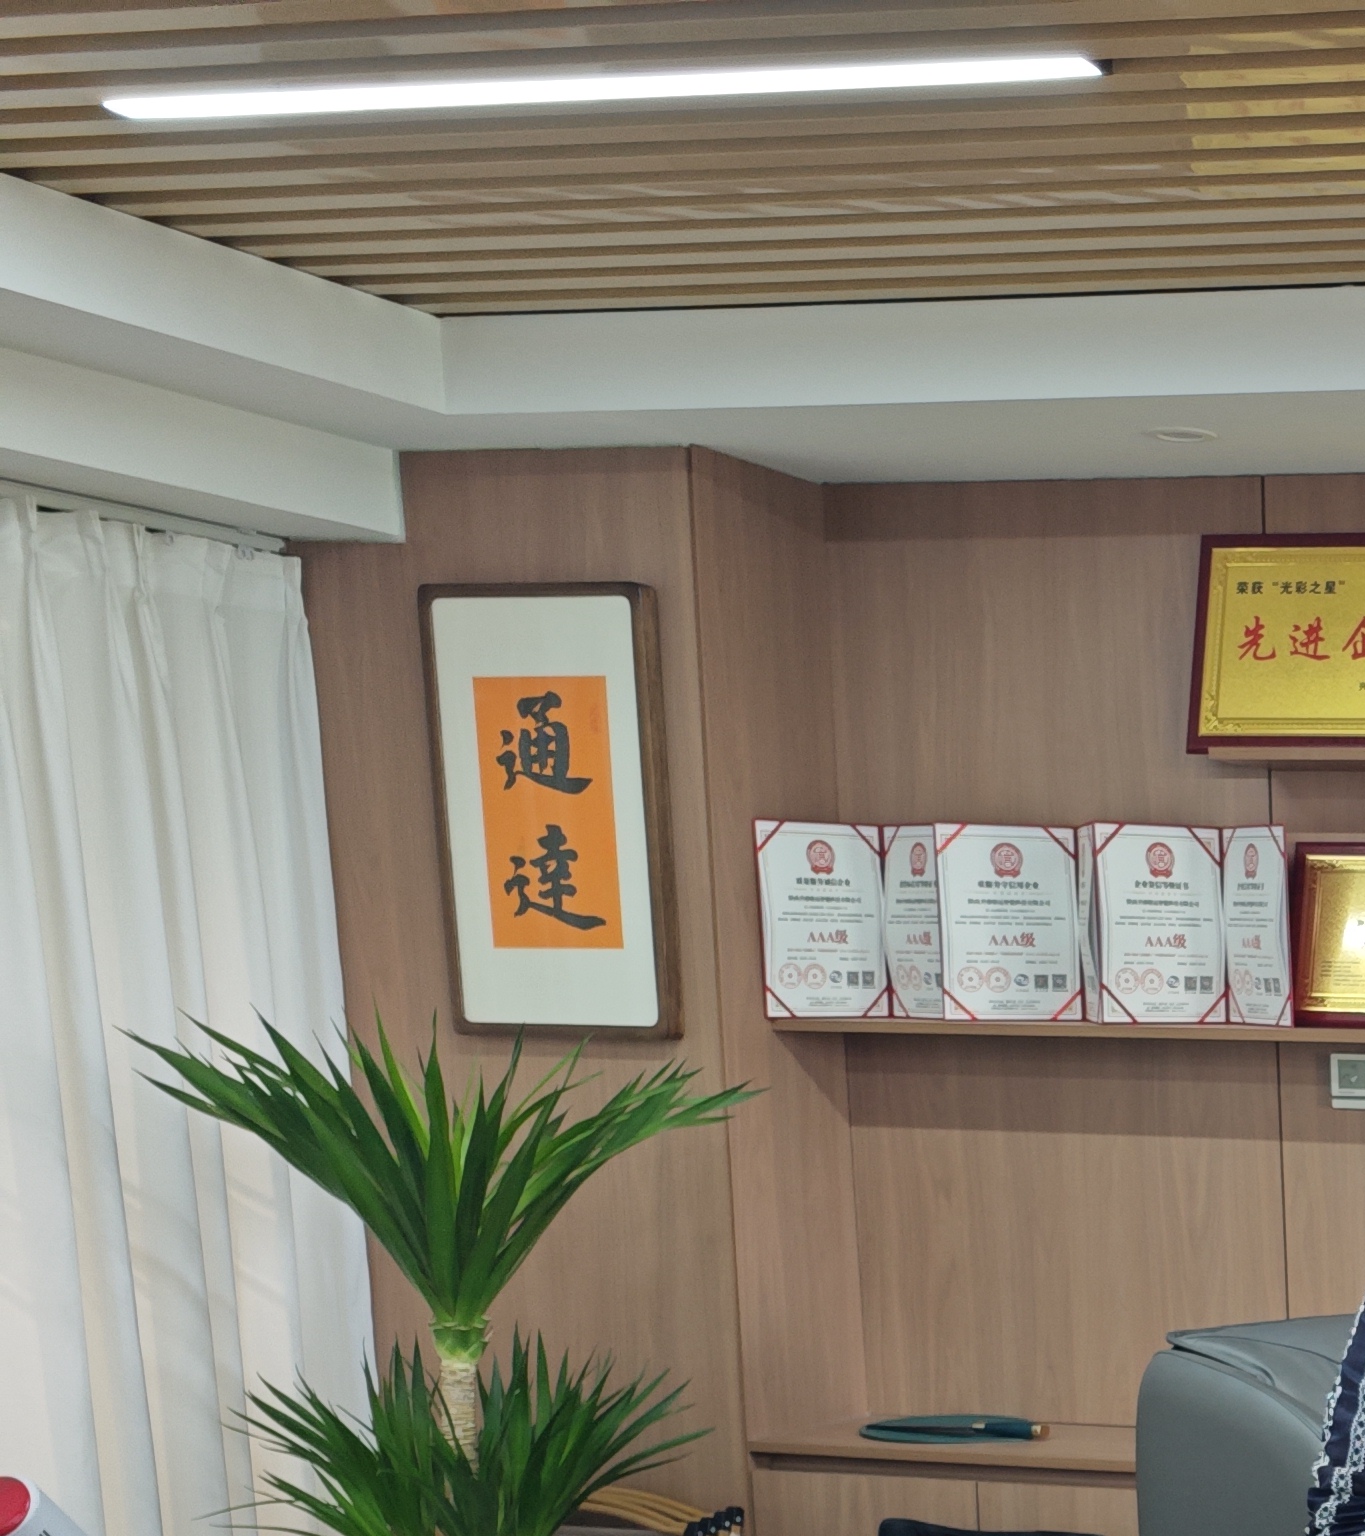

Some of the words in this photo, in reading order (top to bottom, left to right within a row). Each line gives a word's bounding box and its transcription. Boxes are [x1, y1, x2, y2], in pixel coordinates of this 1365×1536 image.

[495, 691, 607, 931] 通達
[988, 932, 1036, 948] AAA级
[1145, 933, 1187, 949] AAA级
